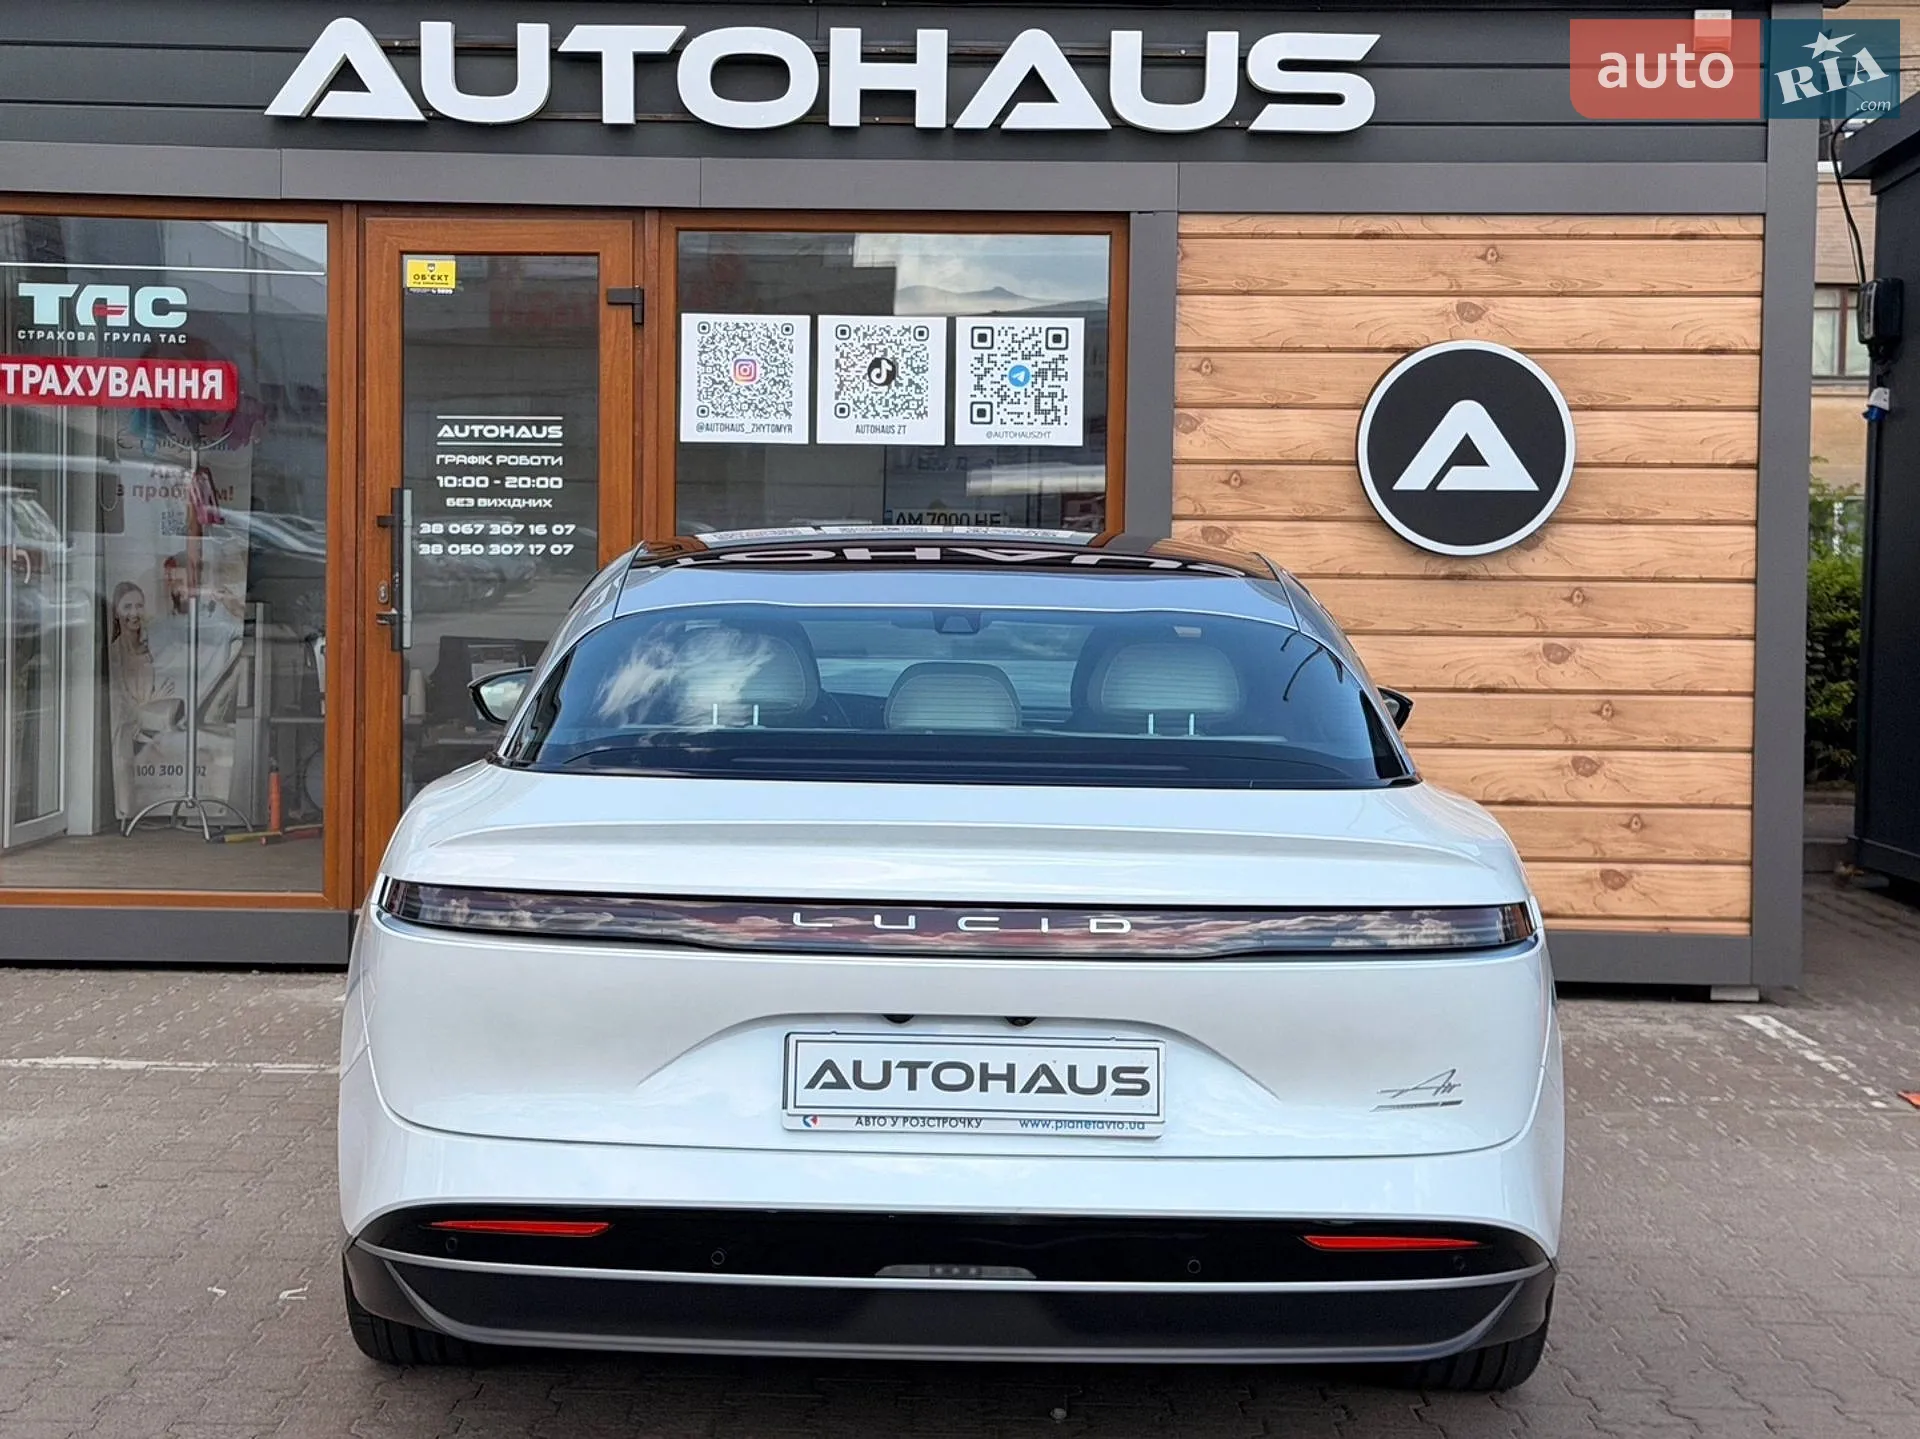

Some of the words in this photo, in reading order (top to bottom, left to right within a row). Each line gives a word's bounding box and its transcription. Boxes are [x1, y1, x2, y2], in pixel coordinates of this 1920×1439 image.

[265, 16, 1381, 133] AUTOHAUS
[18, 283, 188, 329] ТАС
[17, 329, 96, 342] СТРАХОВА
[103, 332, 152, 344] ГРУПА
[160, 334, 187, 344] ТАС
[437, 424, 563, 439] AUTOHAUS
[696, 422, 793, 435] @AUTOHAUS_ZHYTOMYR
[855, 423, 896, 435] AUTOHAUS
[897, 424, 907, 435] ZT
[985, 430, 1052, 440] @AUTOHAUSZHT
[436, 454, 493, 466] ГРАФІК
[496, 455, 563, 467] РОБОТИ
[436, 476, 489, 488] 10:00
[504, 477, 563, 489] 20:00
[446, 497, 475, 507] БЕЗ
[477, 498, 553, 509] ВИХІДНИХ
[419, 523, 444, 534] 38
[448, 523, 484, 534] 067
[488, 524, 524, 535] 307
[529, 524, 547, 535] 16
[551, 524, 576, 536] 07
[418, 544, 443, 555] 38
[447, 544, 484, 555] 050
[488, 544, 524, 555] 307
[529, 544, 546, 555] 17
[550, 544, 574, 555] 07
[793, 912, 1132, 933] LUCID
[803, 1058, 1150, 1097] AUTOHAUS
[855, 1115, 888, 1128] АВТО
[890, 1116, 899, 1128] У
[902, 1116, 984, 1129] РОЗСТРОЧКУ
